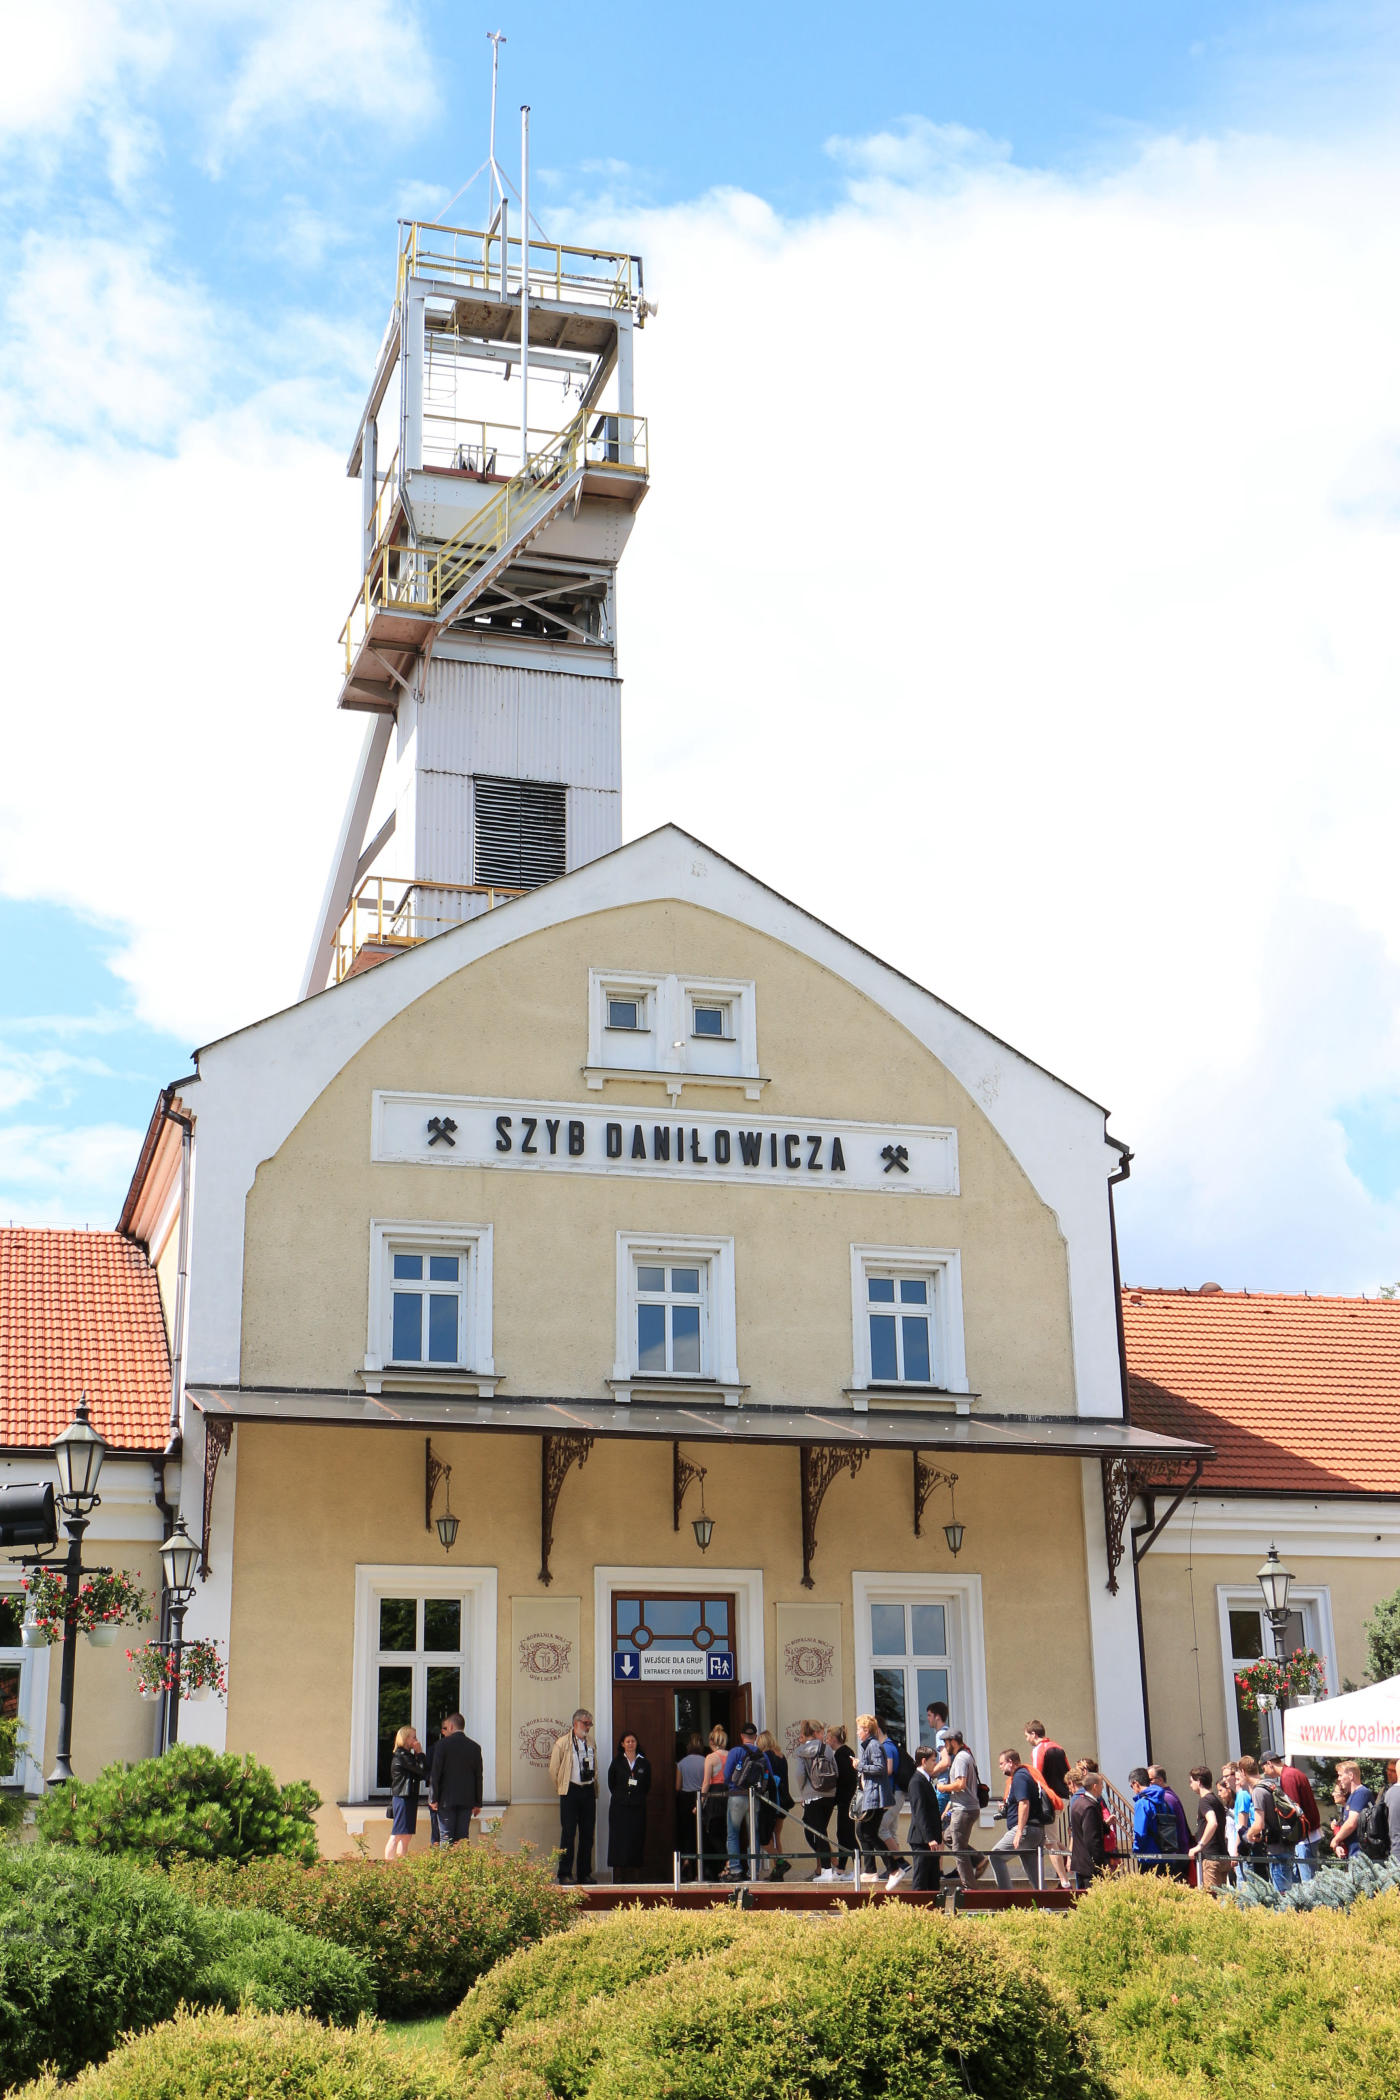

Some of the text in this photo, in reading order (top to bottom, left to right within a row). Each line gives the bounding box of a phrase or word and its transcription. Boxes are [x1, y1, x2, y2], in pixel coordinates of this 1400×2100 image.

[496, 1116, 846, 1171] SZYB DANIŁOWICZA
[644, 1656, 704, 1665] WEJŚCIE DLA GRUP
